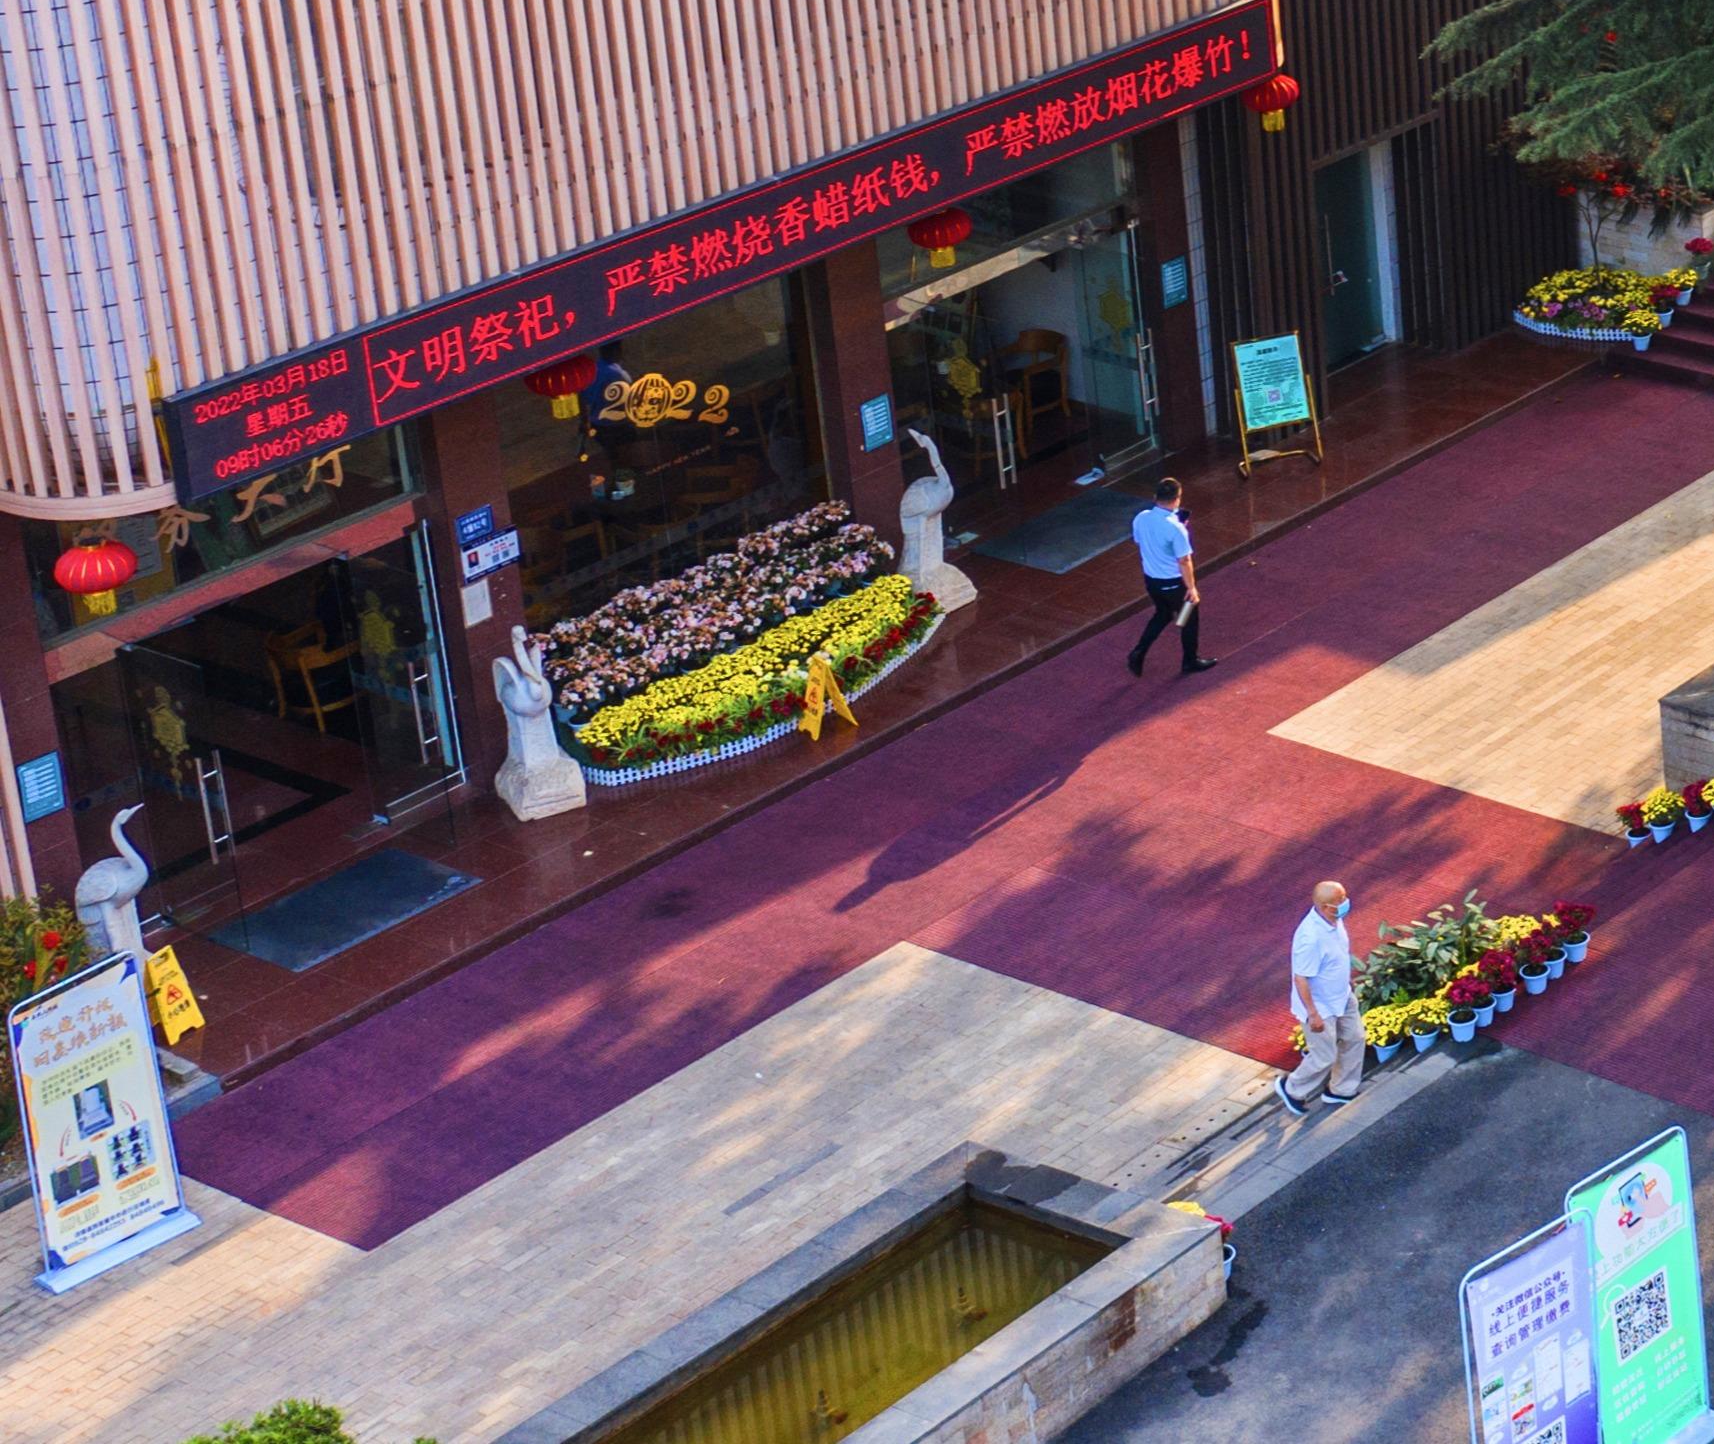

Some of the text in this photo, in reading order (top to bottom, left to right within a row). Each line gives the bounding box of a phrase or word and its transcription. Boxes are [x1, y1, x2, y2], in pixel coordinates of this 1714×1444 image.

[194, 350, 349, 424] 2022年03月18日
[245, 396, 313, 437] 星期五
[1592, 1211, 1681, 1278] 上功能太方便了
[1488, 1282, 1571, 1336] 线上便捷服务
